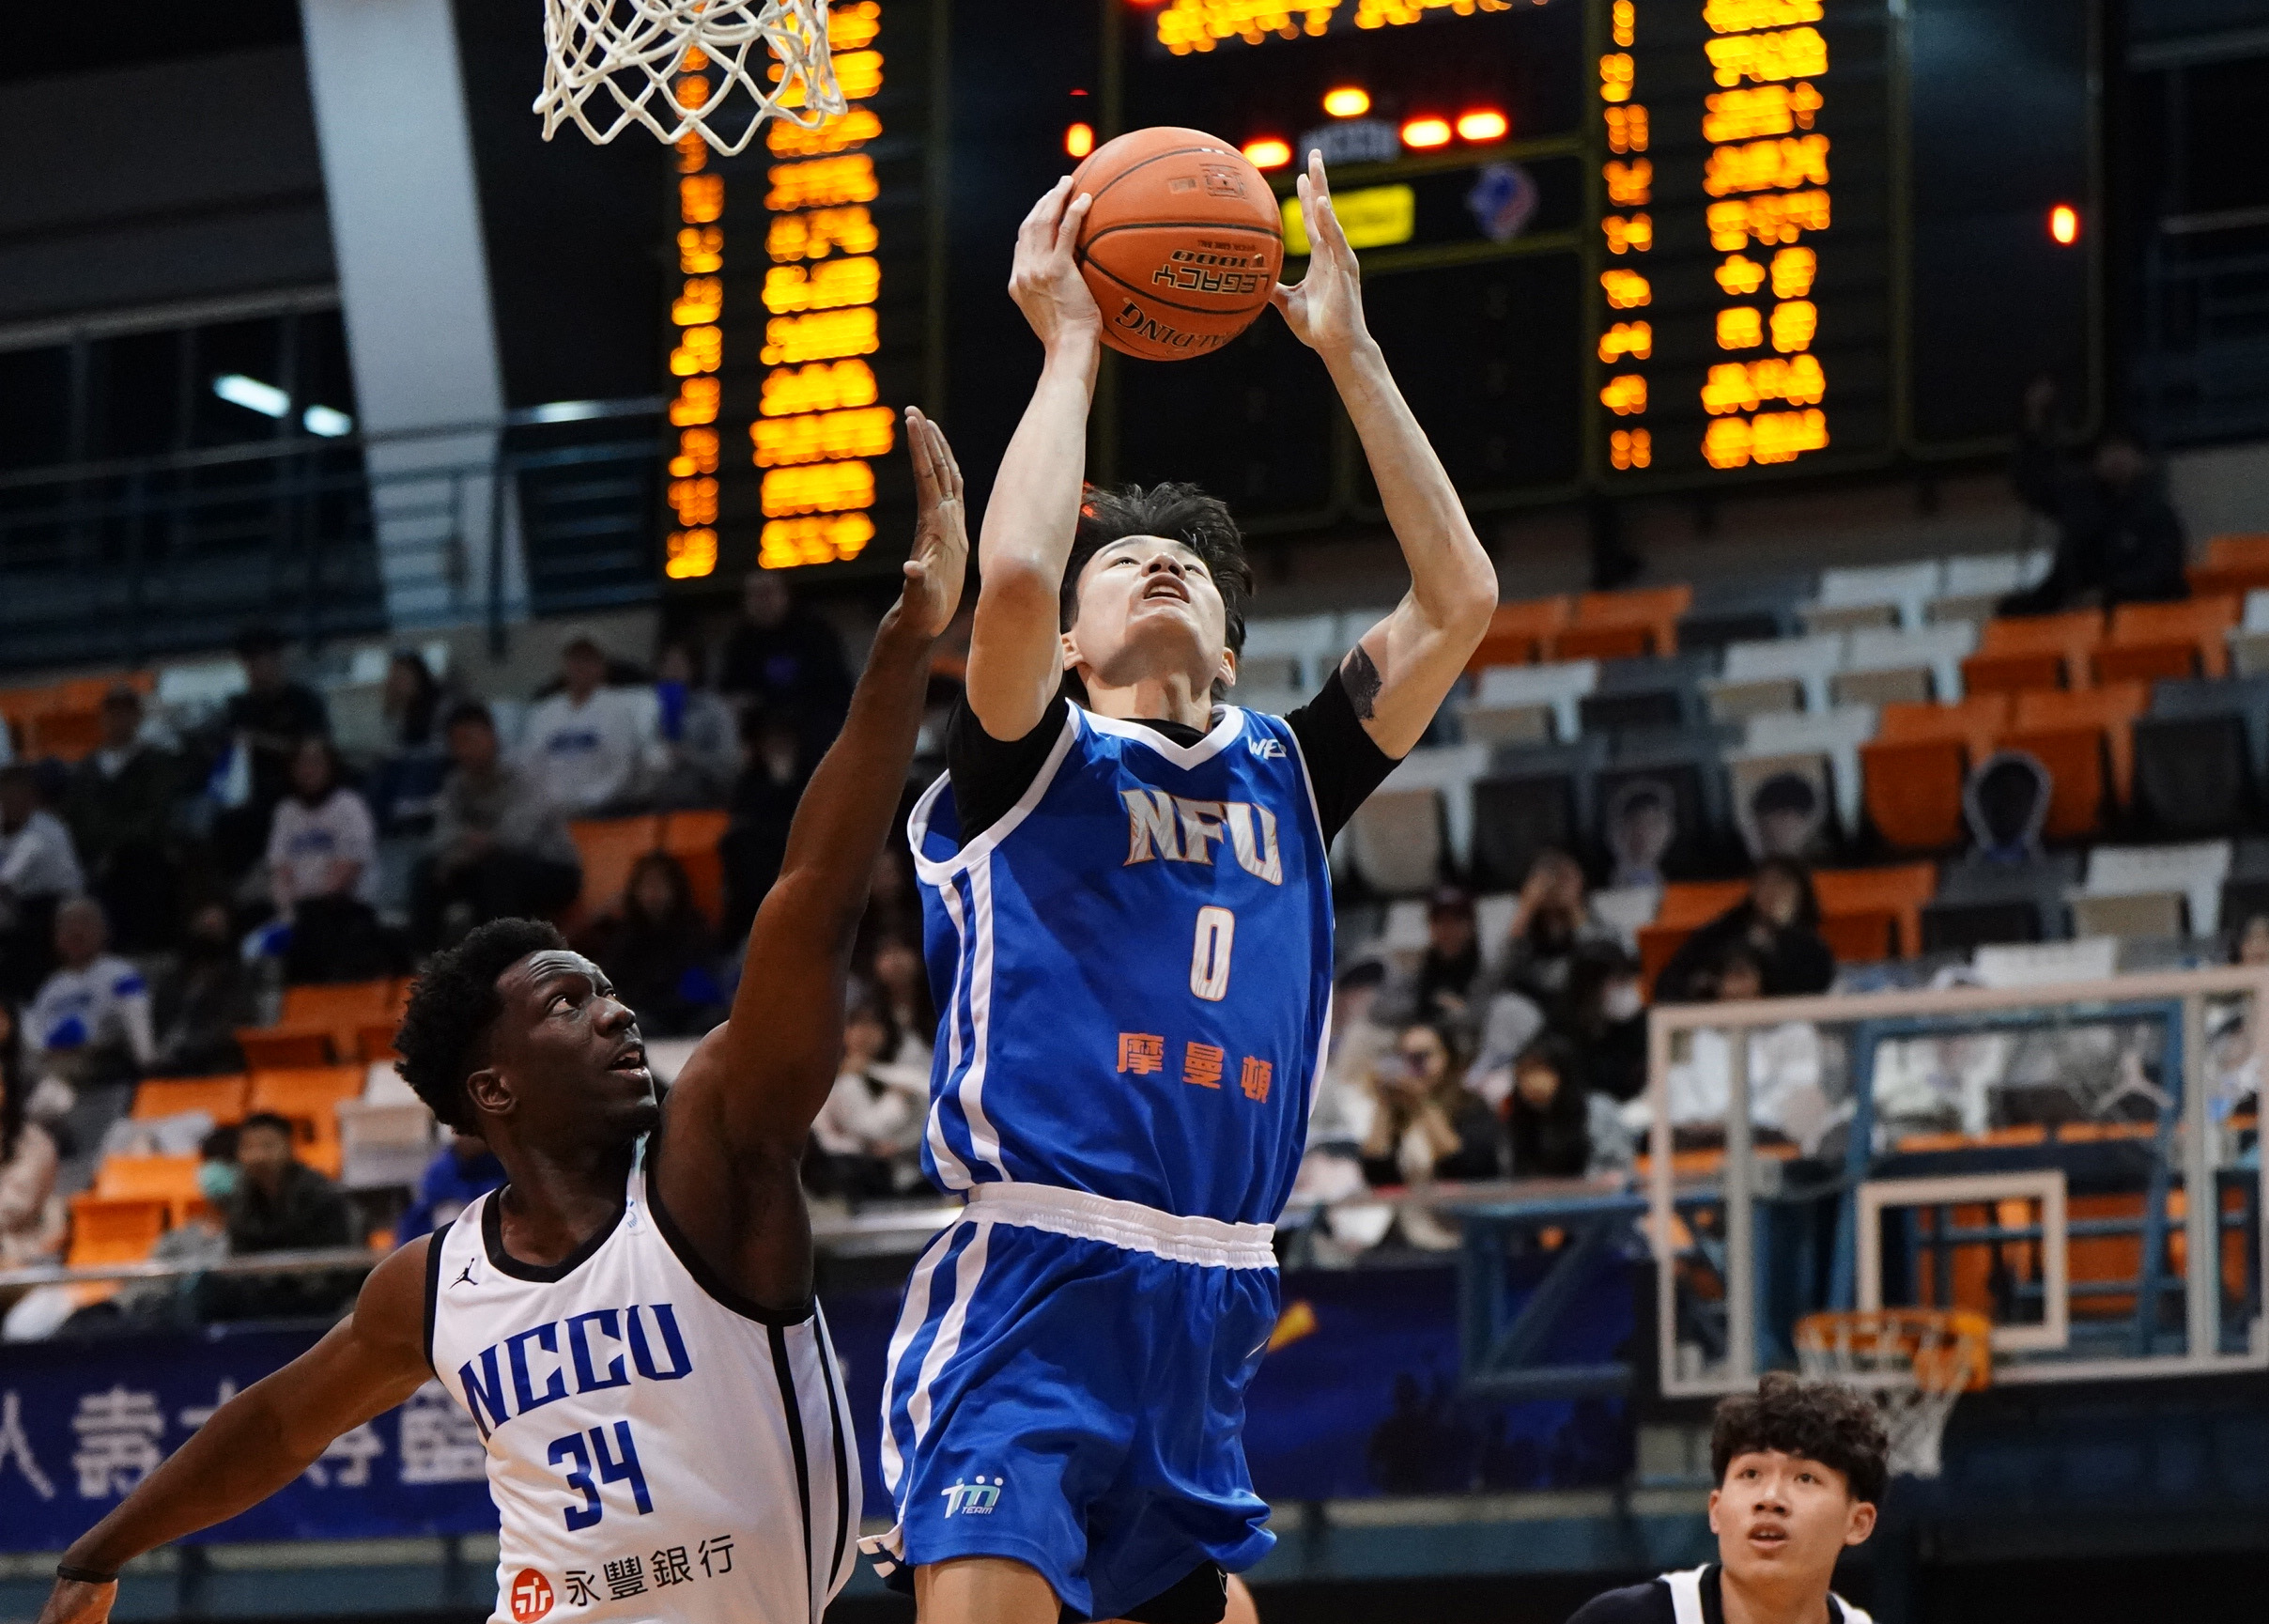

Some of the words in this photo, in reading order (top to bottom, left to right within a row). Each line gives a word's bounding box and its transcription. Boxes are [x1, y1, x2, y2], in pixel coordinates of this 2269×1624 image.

[1152, 264, 1271, 294] LEGACY
[1119, 789, 1283, 886] NFU
[1190, 905, 1235, 1002] 0
[1117, 1032, 1273, 1105] 摩曼頓
[458, 1304, 693, 1444] NCCU
[548, 1420, 655, 1532] 34
[961, 1506, 994, 1515] TEAM
[564, 1535, 734, 1607] 永豐銀行
